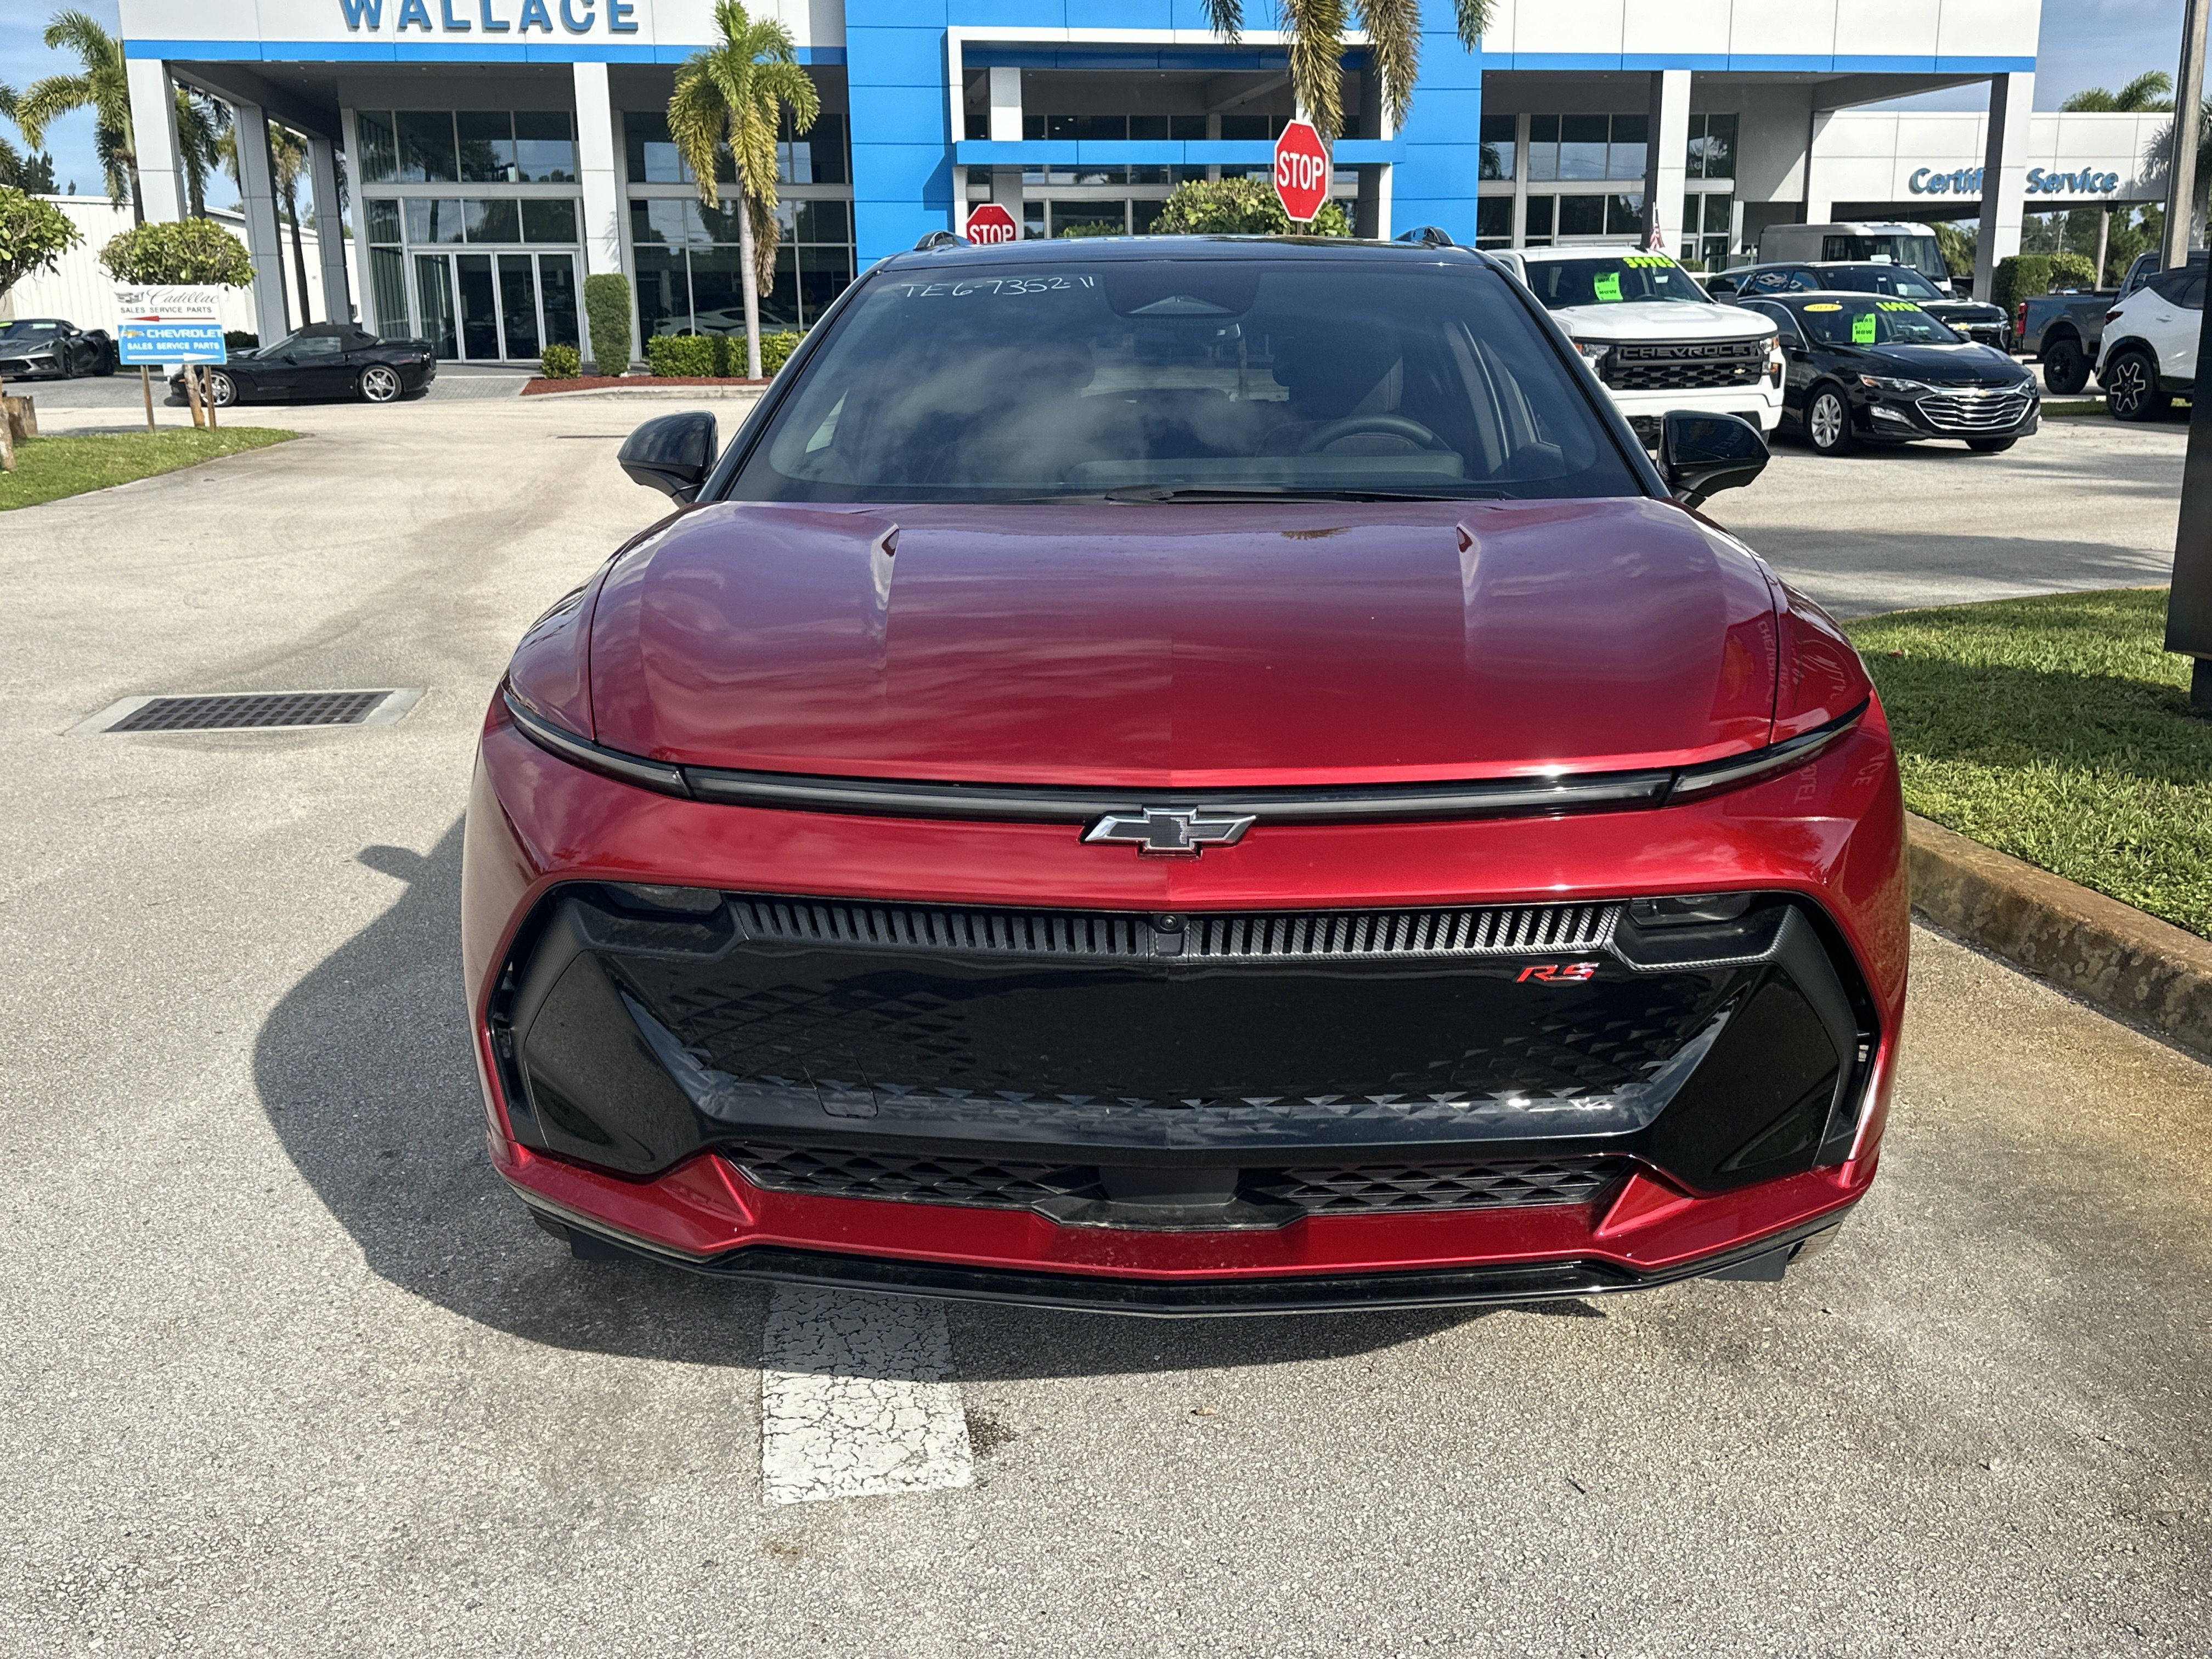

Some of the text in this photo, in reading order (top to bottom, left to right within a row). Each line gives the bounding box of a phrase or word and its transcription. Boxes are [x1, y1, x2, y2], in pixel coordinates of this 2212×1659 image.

[341, 0, 638, 32] WALLACE
[1278, 151, 1324, 191] STOP
[1909, 166, 2119, 195] Certif Service
[969, 224, 1014, 244] STOP
[146, 287, 219, 306] Cadillac
[146, 329, 223, 338] CHEVROLET
[1623, 343, 1758, 358] CHEVROLET
[1516, 962, 1600, 983] RS
